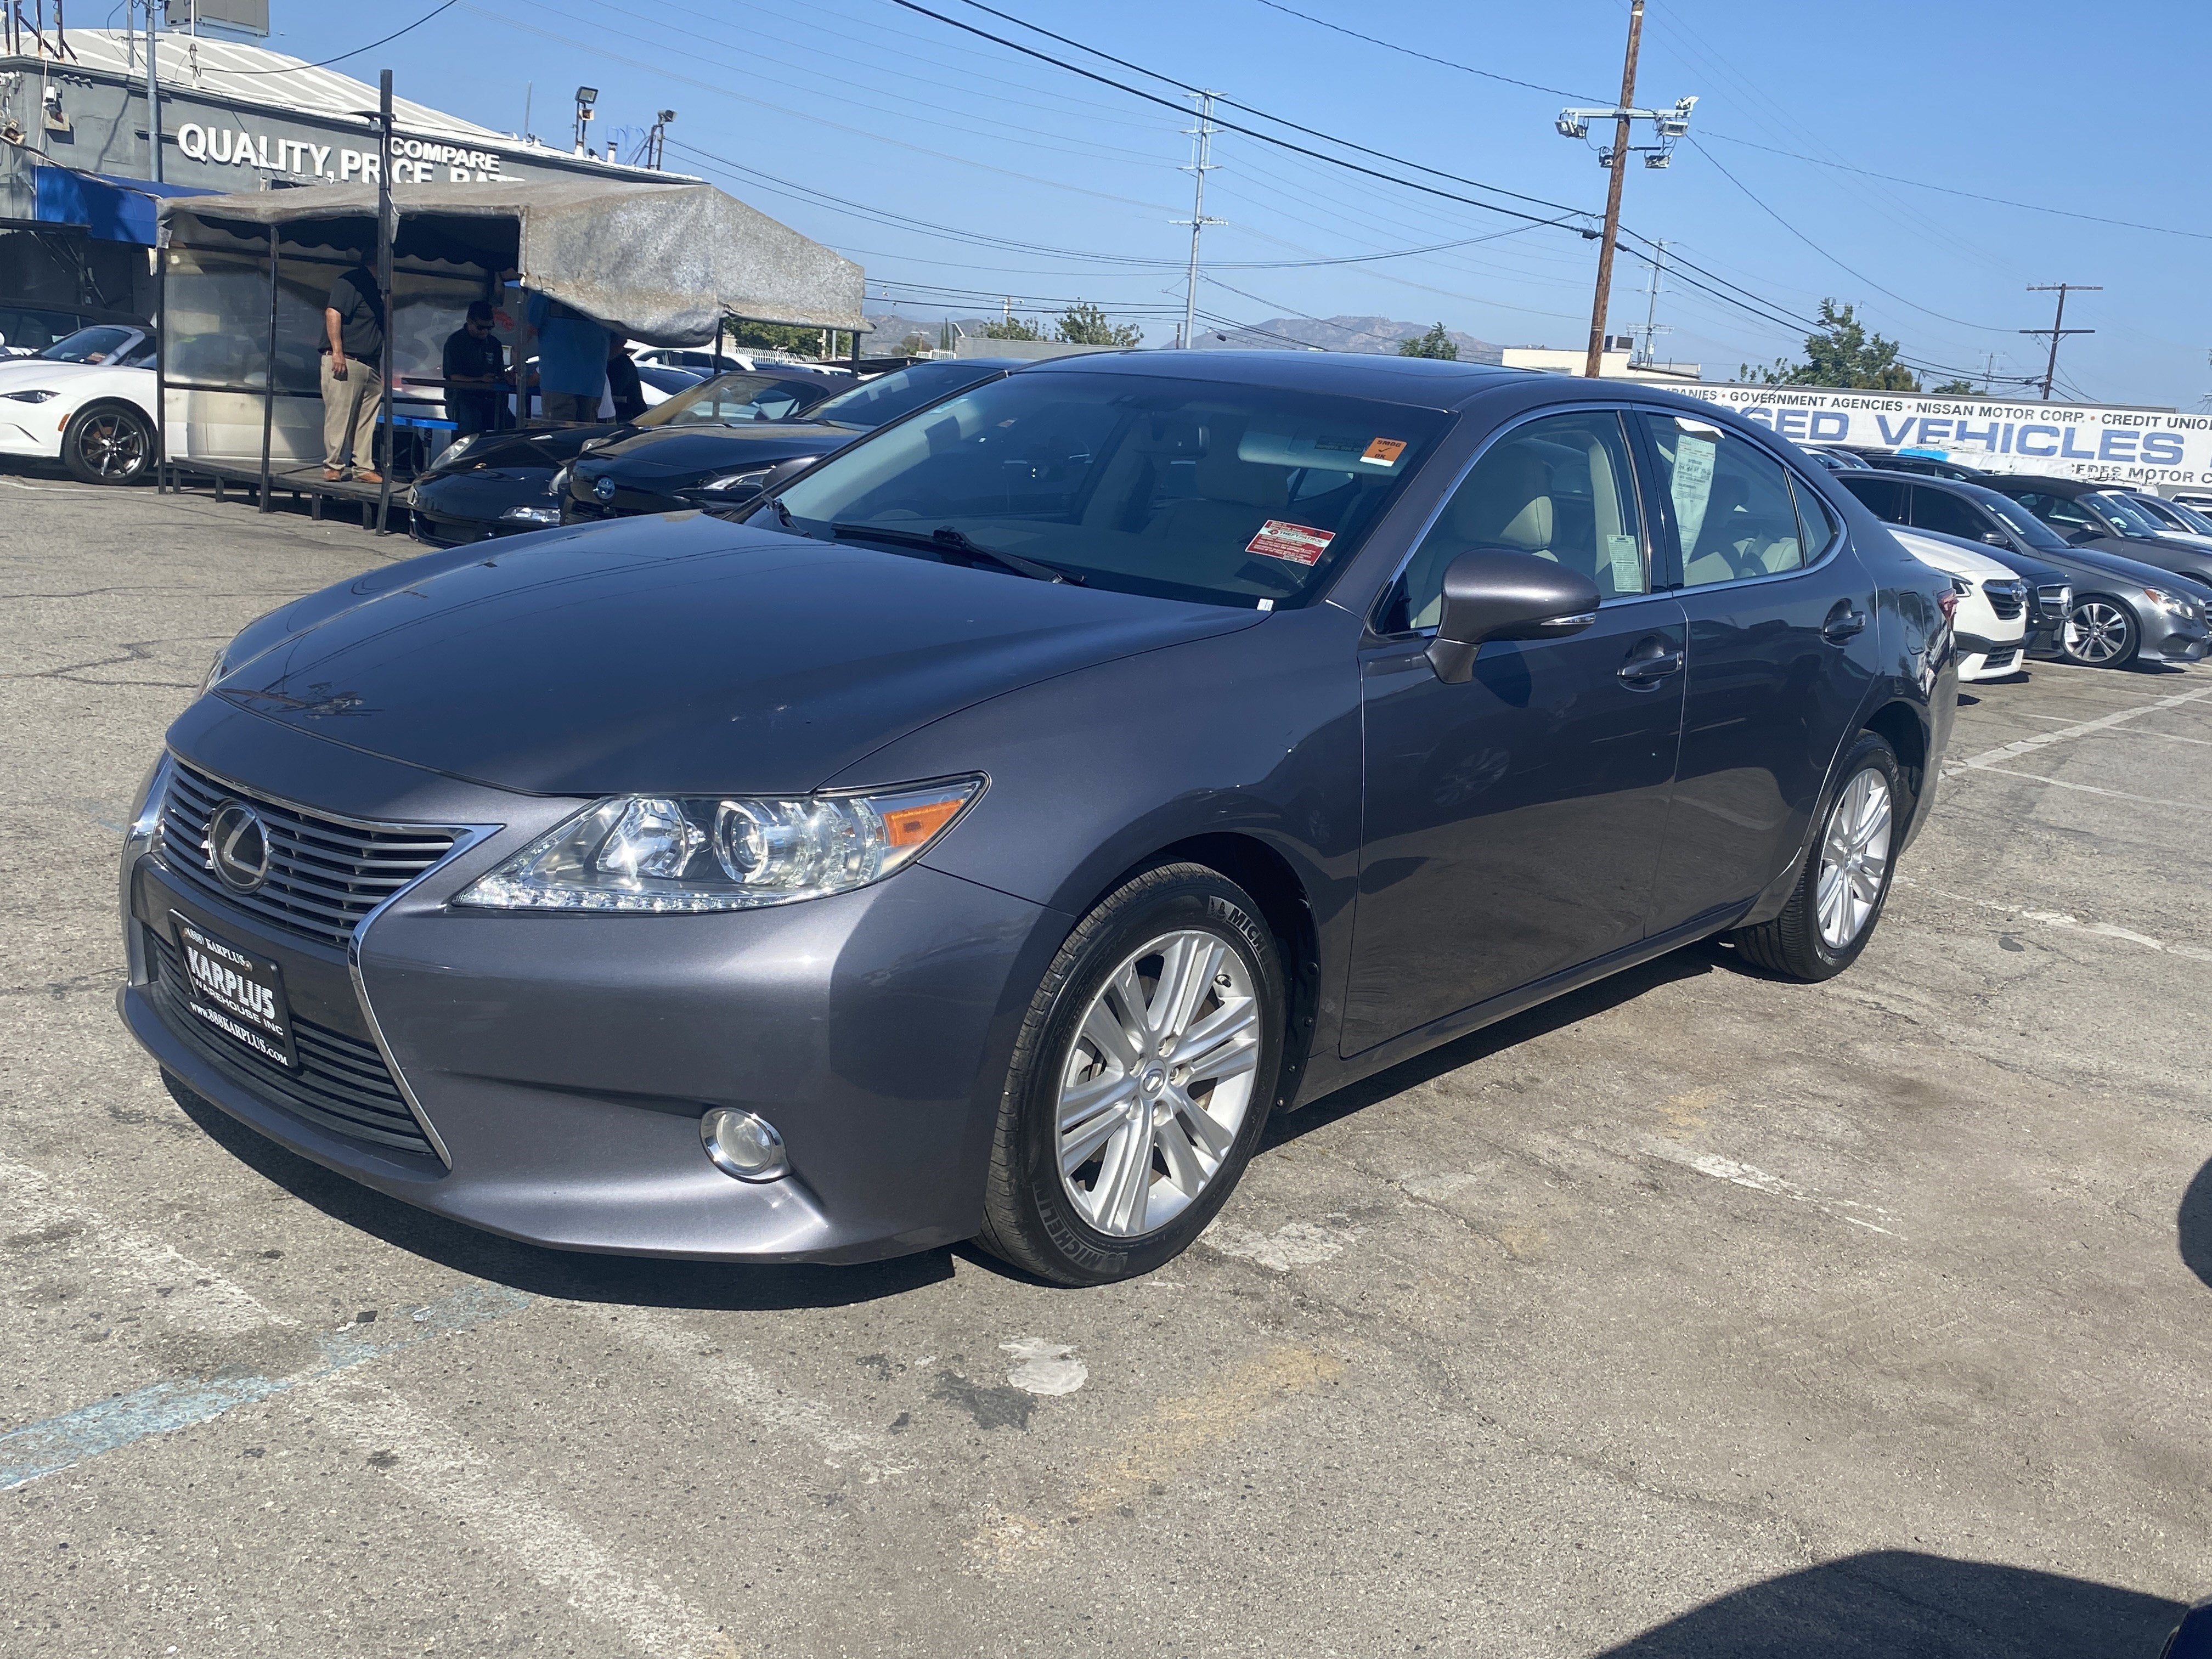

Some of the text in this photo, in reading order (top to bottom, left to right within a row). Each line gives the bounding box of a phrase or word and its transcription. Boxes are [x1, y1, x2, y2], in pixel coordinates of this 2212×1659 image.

[178, 123, 433, 184] QUALITY, PRCE
[391, 137, 500, 172] COMPARE
[1722, 405, 1849, 441] SED
[1875, 415, 2184, 465] VEHICLES
[1730, 392, 1826, 407] GOVERNMENT
[1831, 398, 1903, 411] AGENCIES
[1916, 403, 1974, 415] NISSAN
[1979, 407, 2034, 420] MOTOR
[2102, 414, 2162, 427] CREDIT
[2167, 417, 2212, 431] UNIO
[2129, 467, 2194, 483] MOTOR
[205, 938, 245, 966] KARPLUS
[187, 946, 275, 1019] KARPLUS
[192, 975, 284, 1036] WAREHOUSE INC
